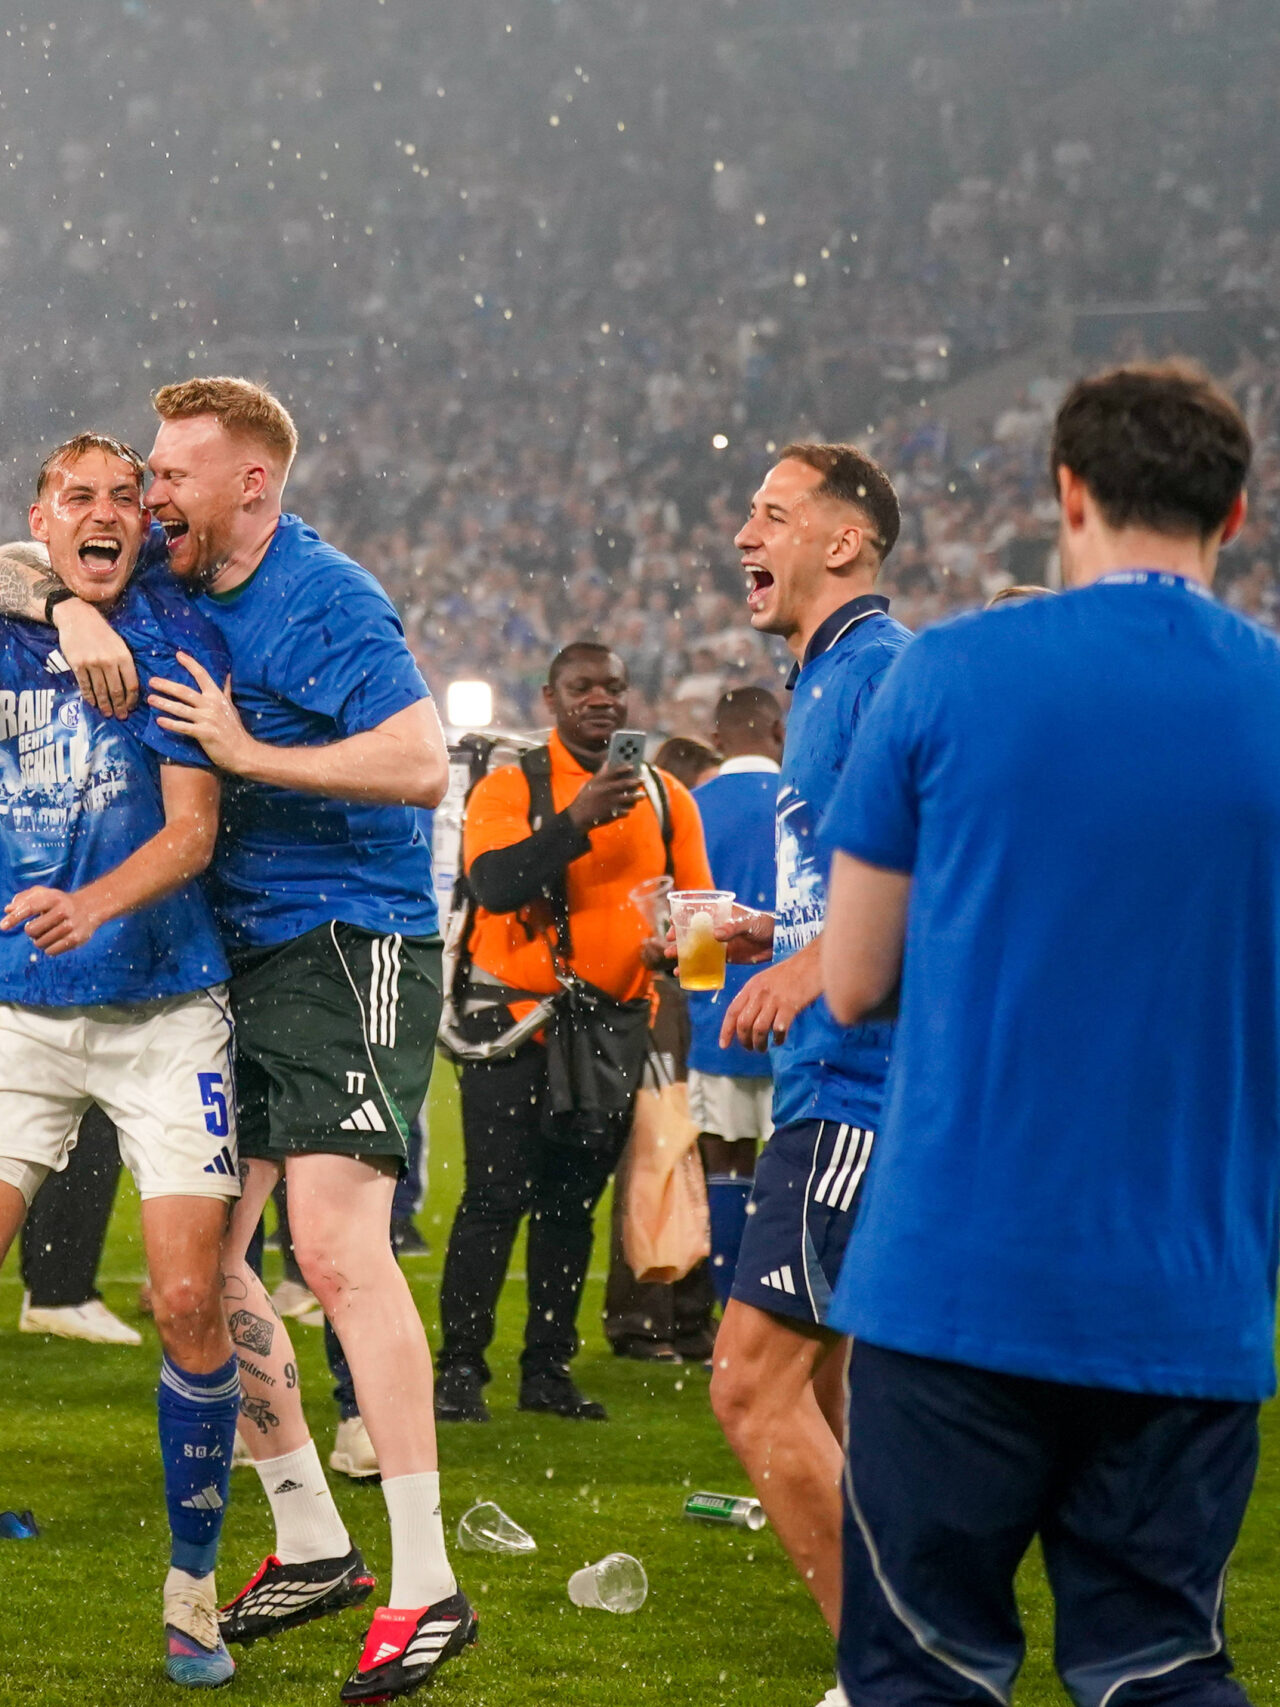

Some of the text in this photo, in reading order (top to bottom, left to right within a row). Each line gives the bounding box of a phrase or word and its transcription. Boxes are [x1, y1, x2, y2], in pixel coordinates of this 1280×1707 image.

[345, 1071, 366, 1095] TT
[197, 1073, 229, 1137] 5
[183, 1443, 224, 1459] S04
